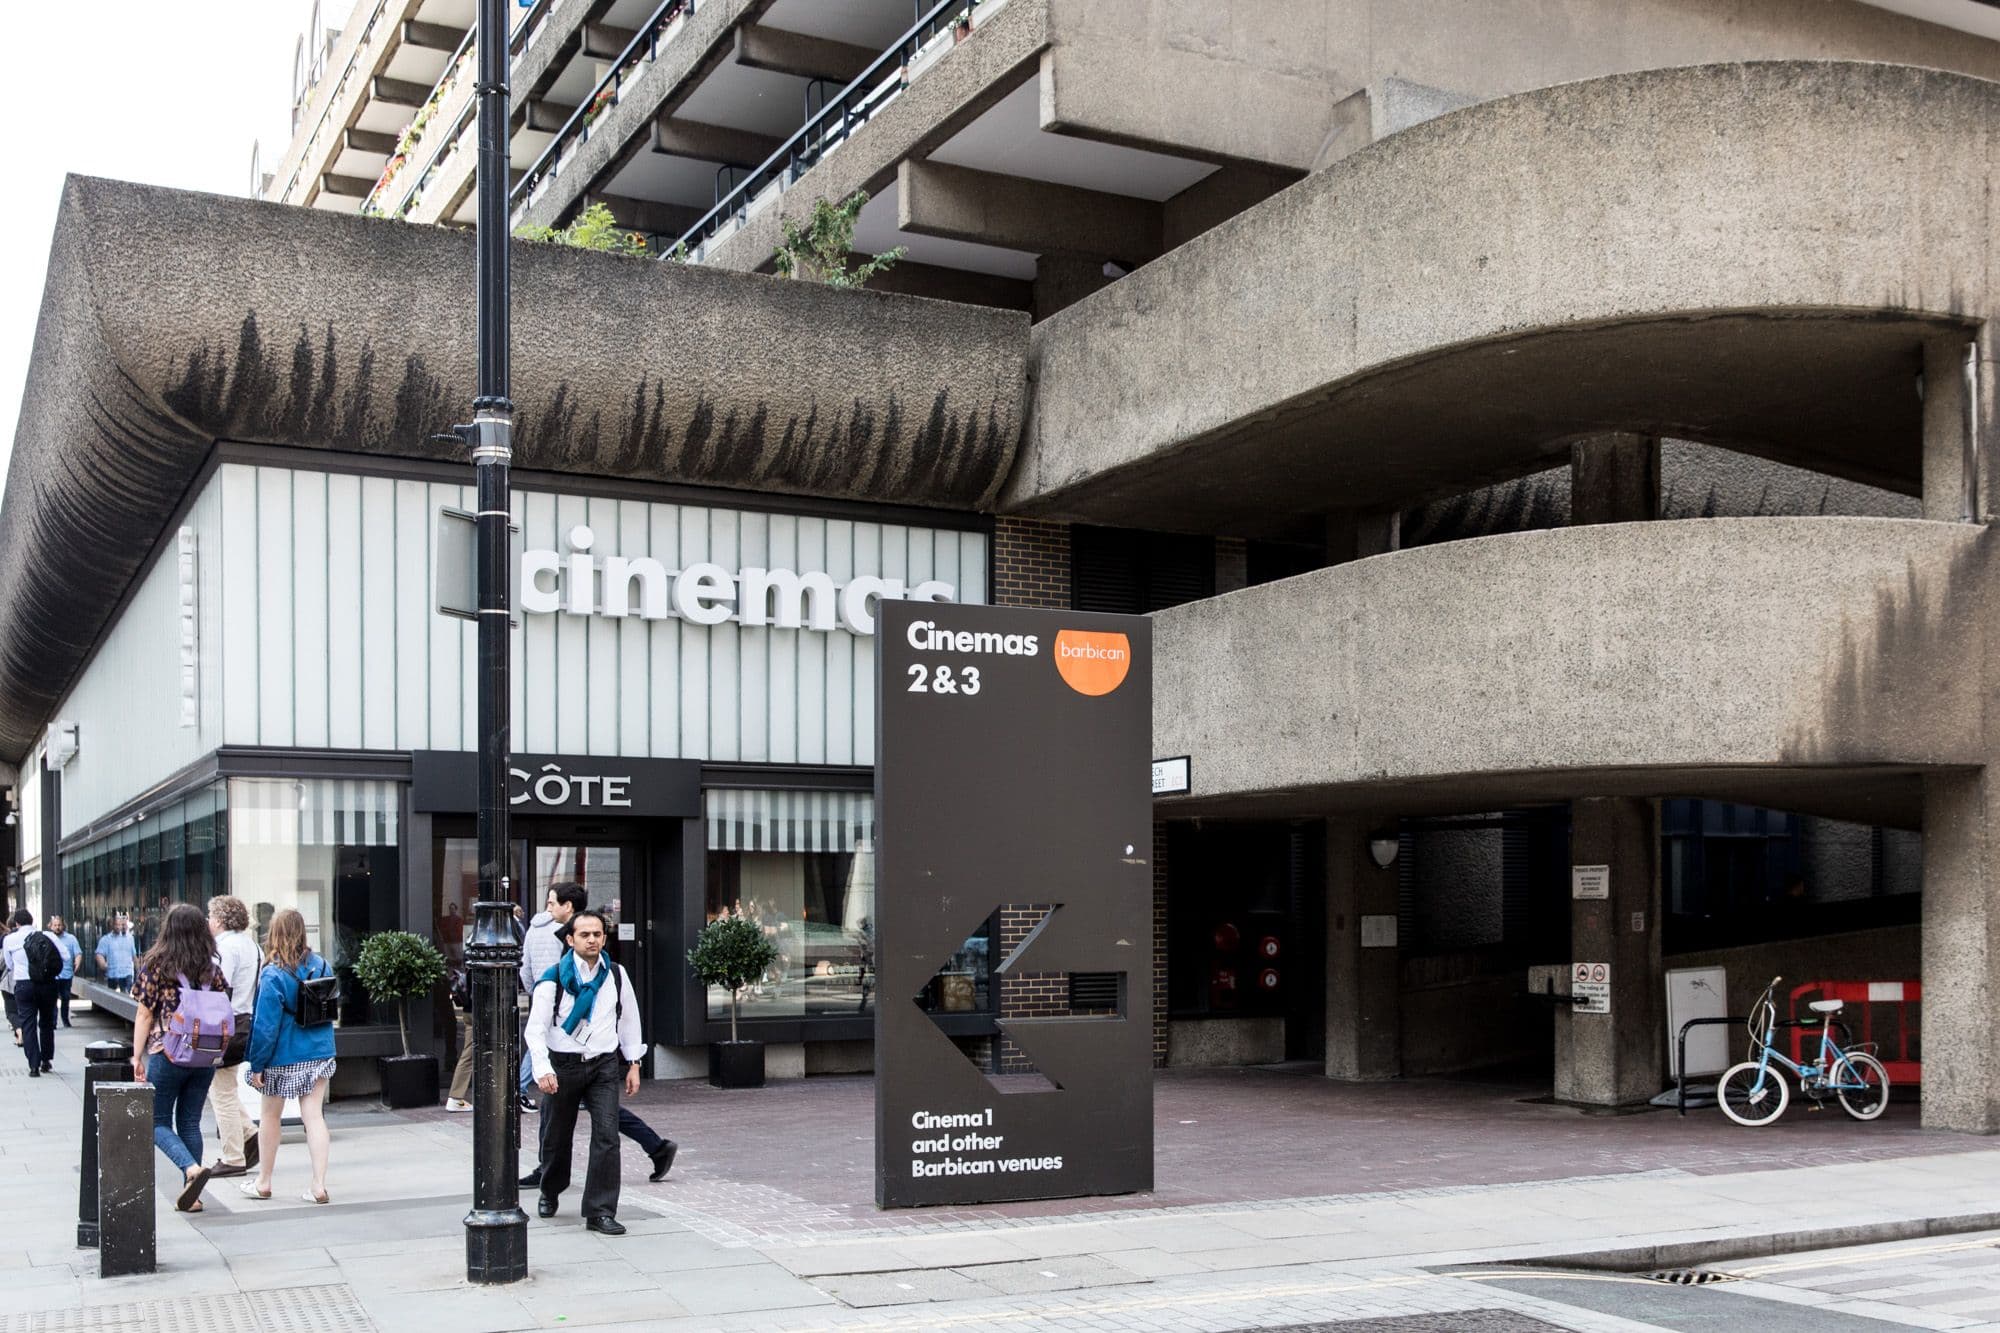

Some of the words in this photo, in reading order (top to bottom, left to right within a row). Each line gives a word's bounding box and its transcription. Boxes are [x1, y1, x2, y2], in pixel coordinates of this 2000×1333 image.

[907, 621, 1039, 656] Cinemas
[1061, 641, 1125, 661] barbican
[907, 664, 928, 692] 2
[932, 666, 958, 694] &
[961, 667, 981, 695] 3
[510, 763, 632, 807] CÔTE
[912, 1111, 983, 1129] Cinema
[985, 1108, 993, 1126] 1
[912, 1134, 949, 1153] and
[952, 1132, 1004, 1151] other
[912, 1157, 995, 1177] Barbican
[997, 1156, 1063, 1172] venues
